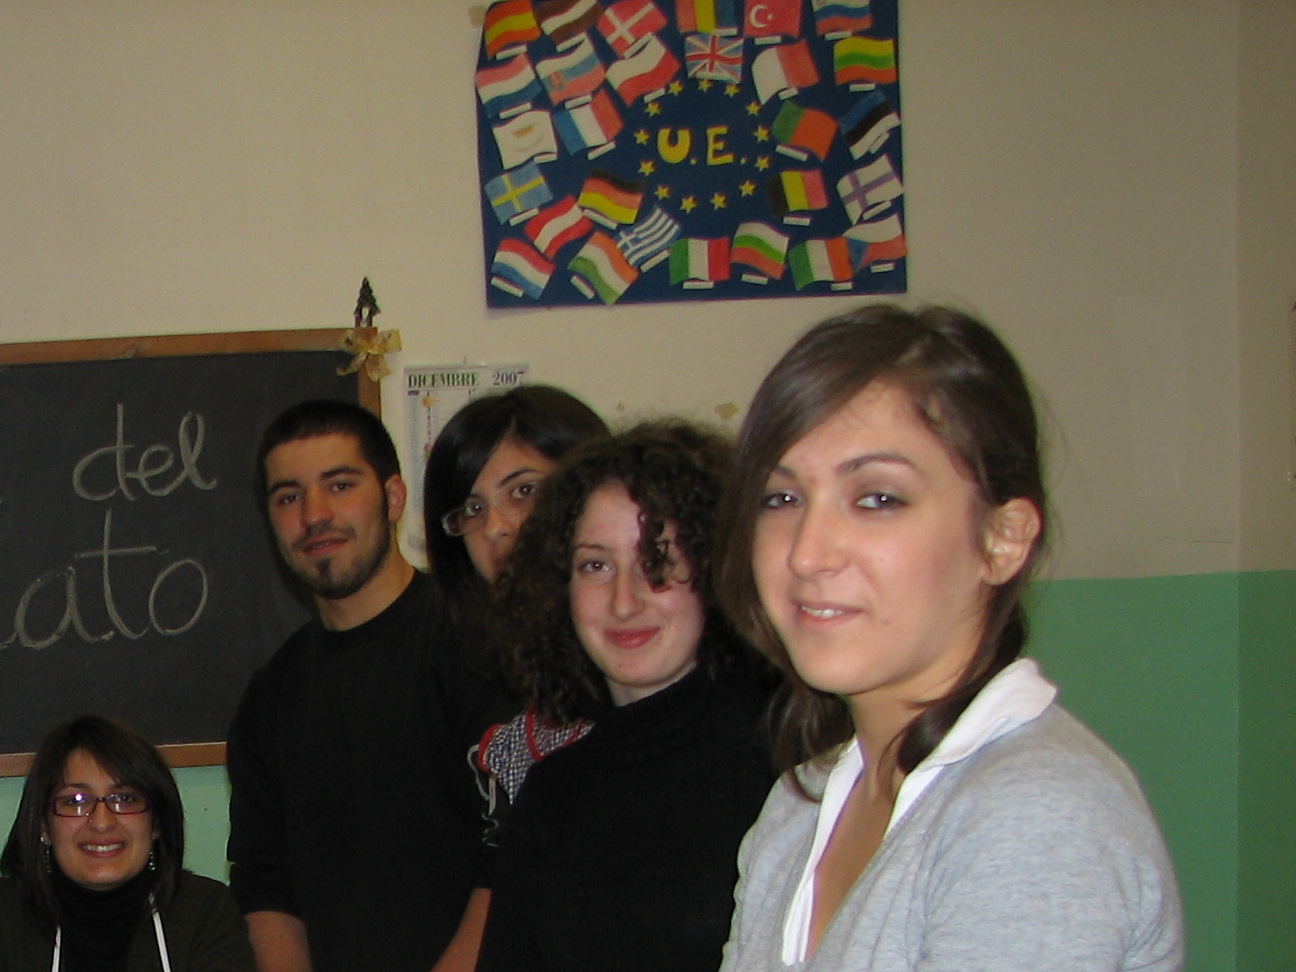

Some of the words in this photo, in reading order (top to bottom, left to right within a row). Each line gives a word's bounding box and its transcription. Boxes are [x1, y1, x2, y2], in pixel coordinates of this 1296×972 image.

[407, 372, 480, 389] DICEMBRE
[492, 369, 525, 387] 2007
[71, 403, 218, 502] del
